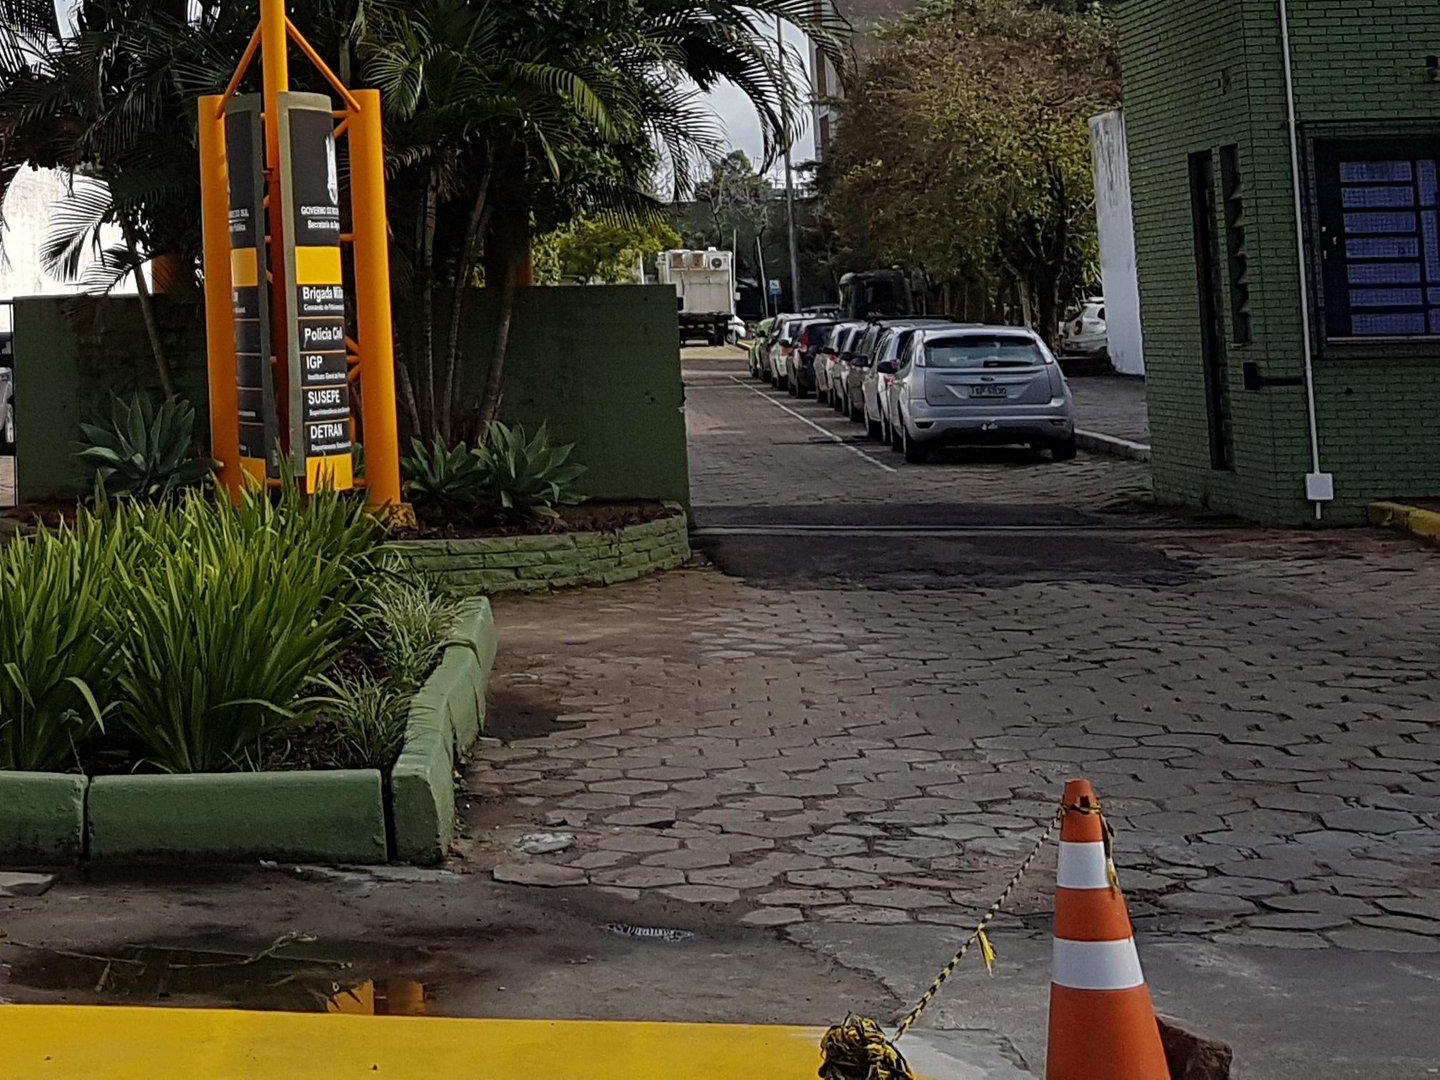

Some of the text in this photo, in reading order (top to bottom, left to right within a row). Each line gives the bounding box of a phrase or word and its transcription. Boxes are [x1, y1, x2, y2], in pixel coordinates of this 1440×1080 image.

[302, 286, 333, 303] Brigada
[306, 355, 323, 370] IGP
[308, 389, 340, 406] SUSEPE
[310, 423, 343, 440] DETRAN
